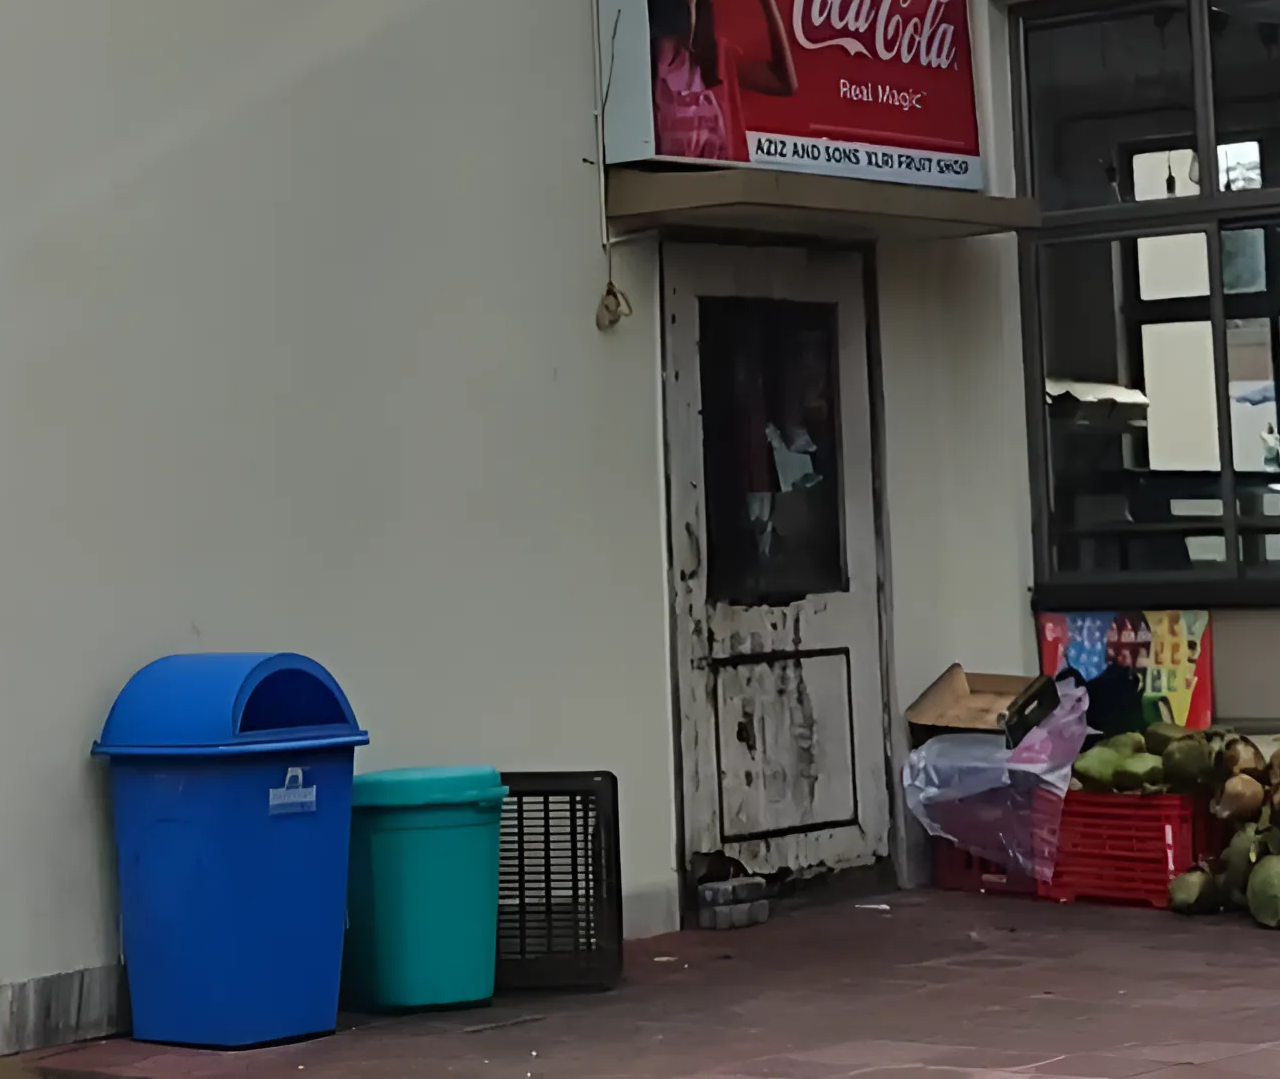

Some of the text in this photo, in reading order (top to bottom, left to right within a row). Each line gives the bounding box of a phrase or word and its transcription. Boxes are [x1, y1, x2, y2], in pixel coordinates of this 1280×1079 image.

[839, 78, 923, 111] Real Magic
[755, 137, 788, 158] AZIZ
[791, 143, 821, 161] AND
[824, 145, 861, 166] SONS
[897, 153, 933, 174] FRUIT
